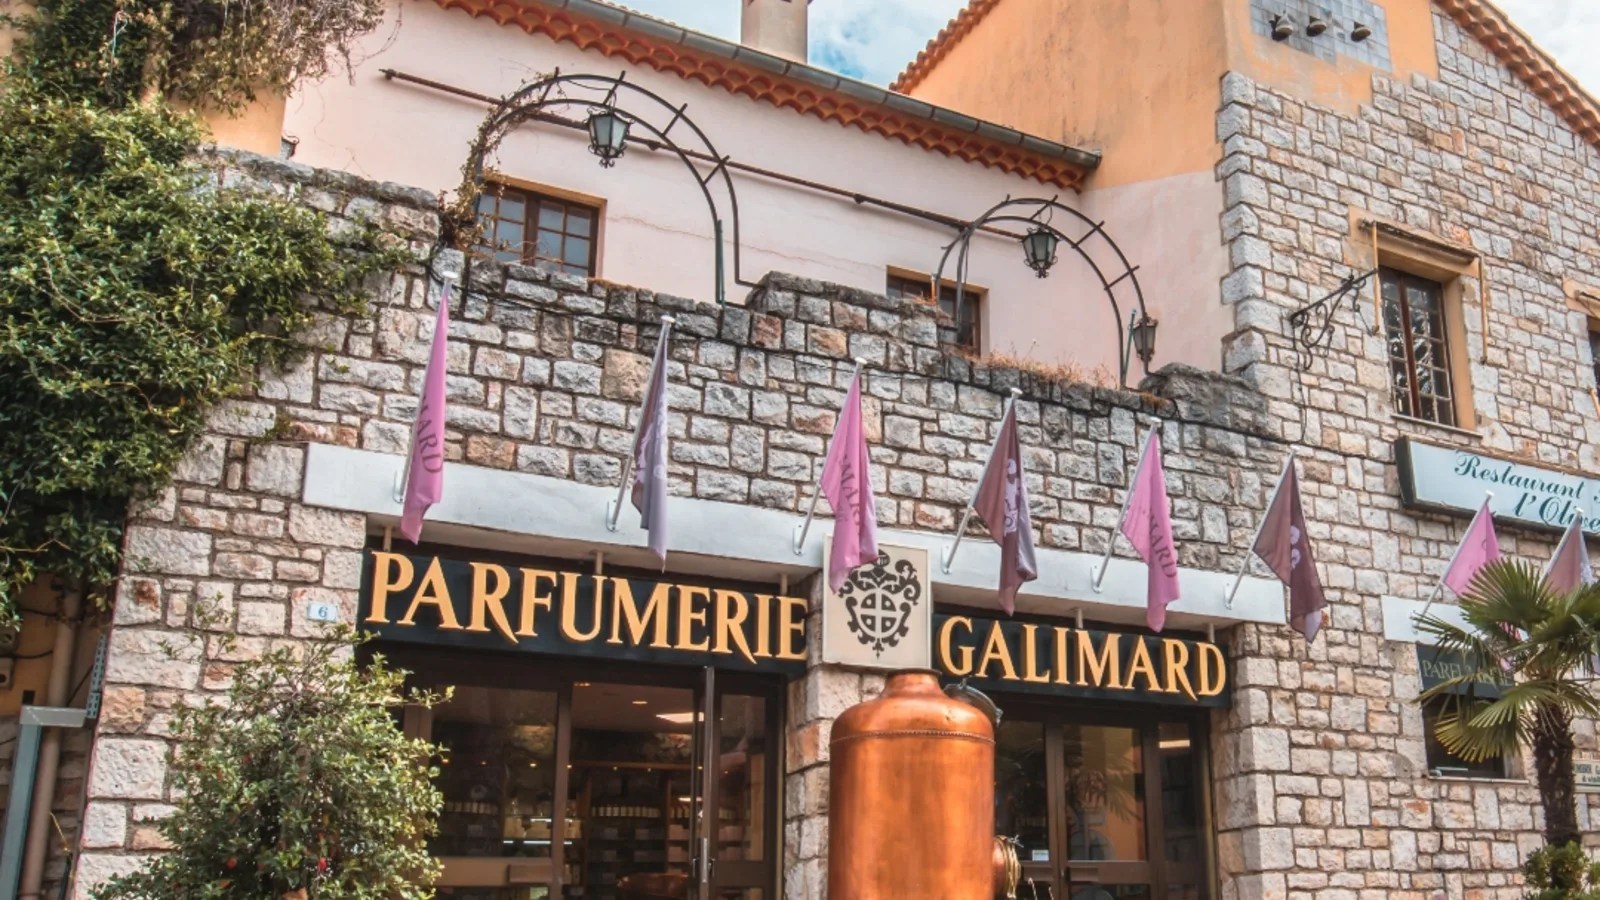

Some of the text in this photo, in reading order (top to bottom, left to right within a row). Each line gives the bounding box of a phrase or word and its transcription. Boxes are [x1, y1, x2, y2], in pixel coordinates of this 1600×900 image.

[1454, 451, 1584, 499] Restaurant
[318, 606, 328, 618] 6
[365, 551, 1227, 701] PARFUMERIE GALIMARD
